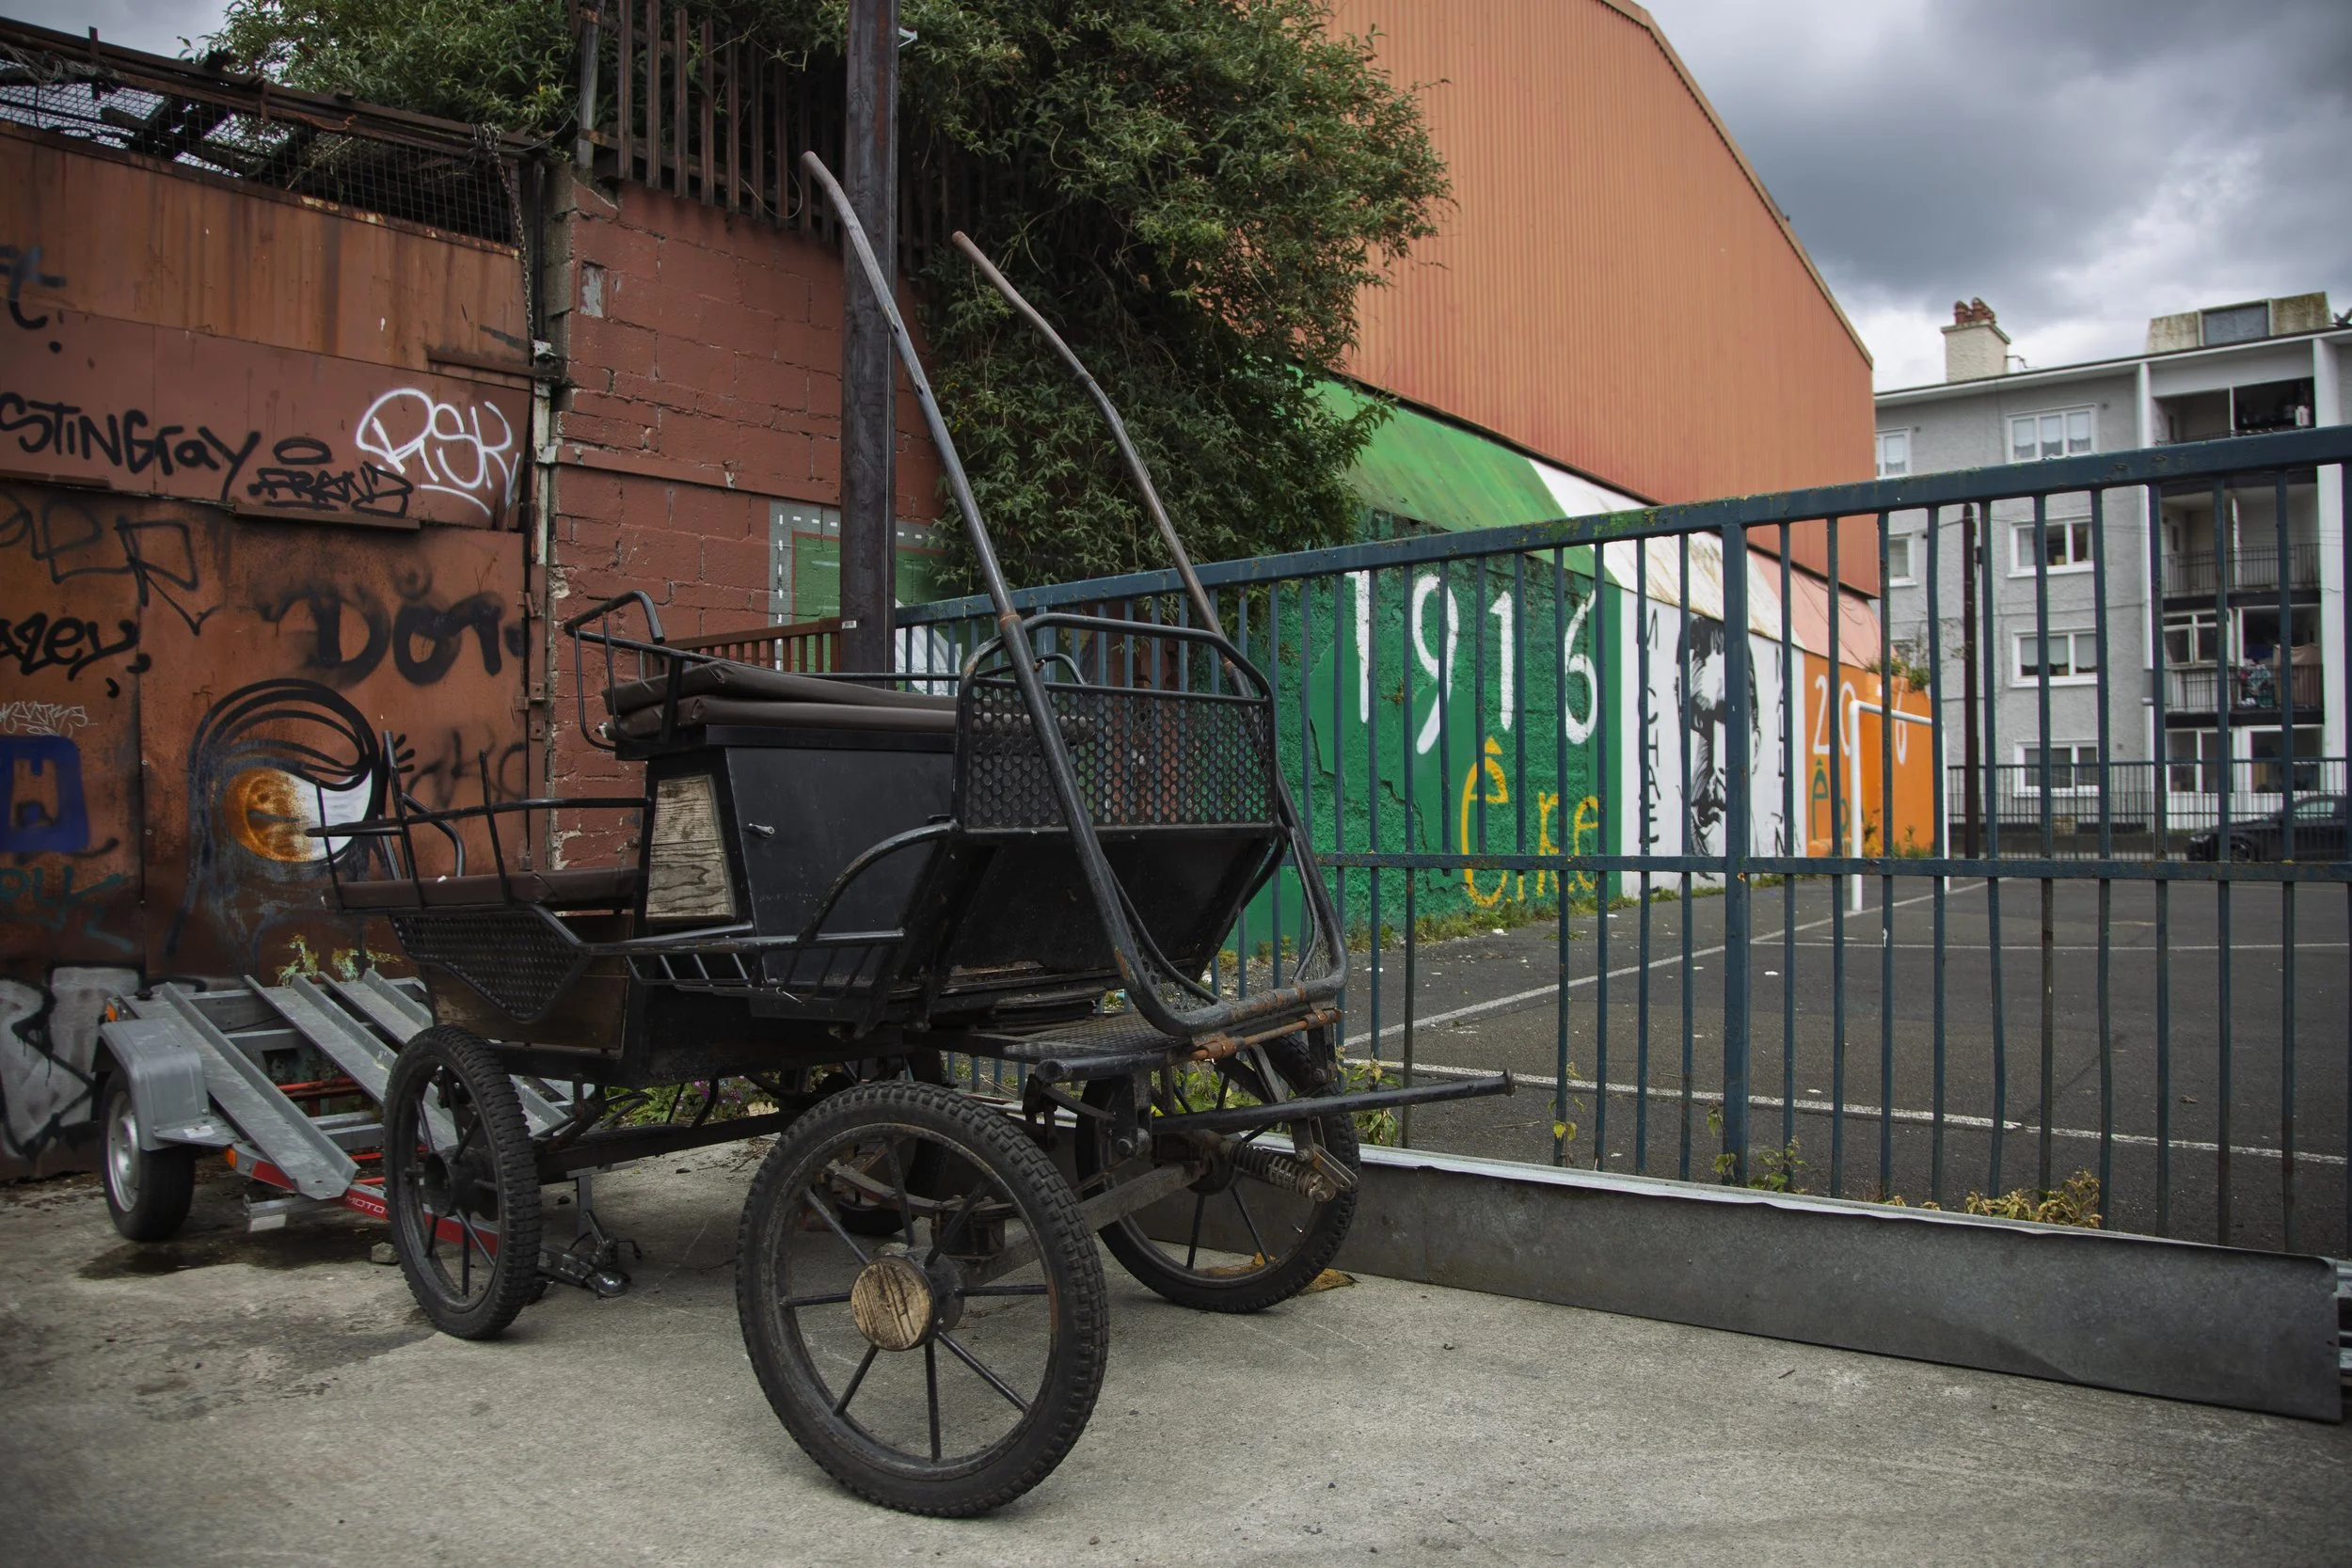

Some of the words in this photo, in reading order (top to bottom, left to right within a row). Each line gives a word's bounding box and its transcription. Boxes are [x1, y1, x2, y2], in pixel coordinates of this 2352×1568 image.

[1343, 568, 1597, 754] 1916
[1813, 673, 1907, 766] 206
[345, 1196, 385, 1214] MOTO
